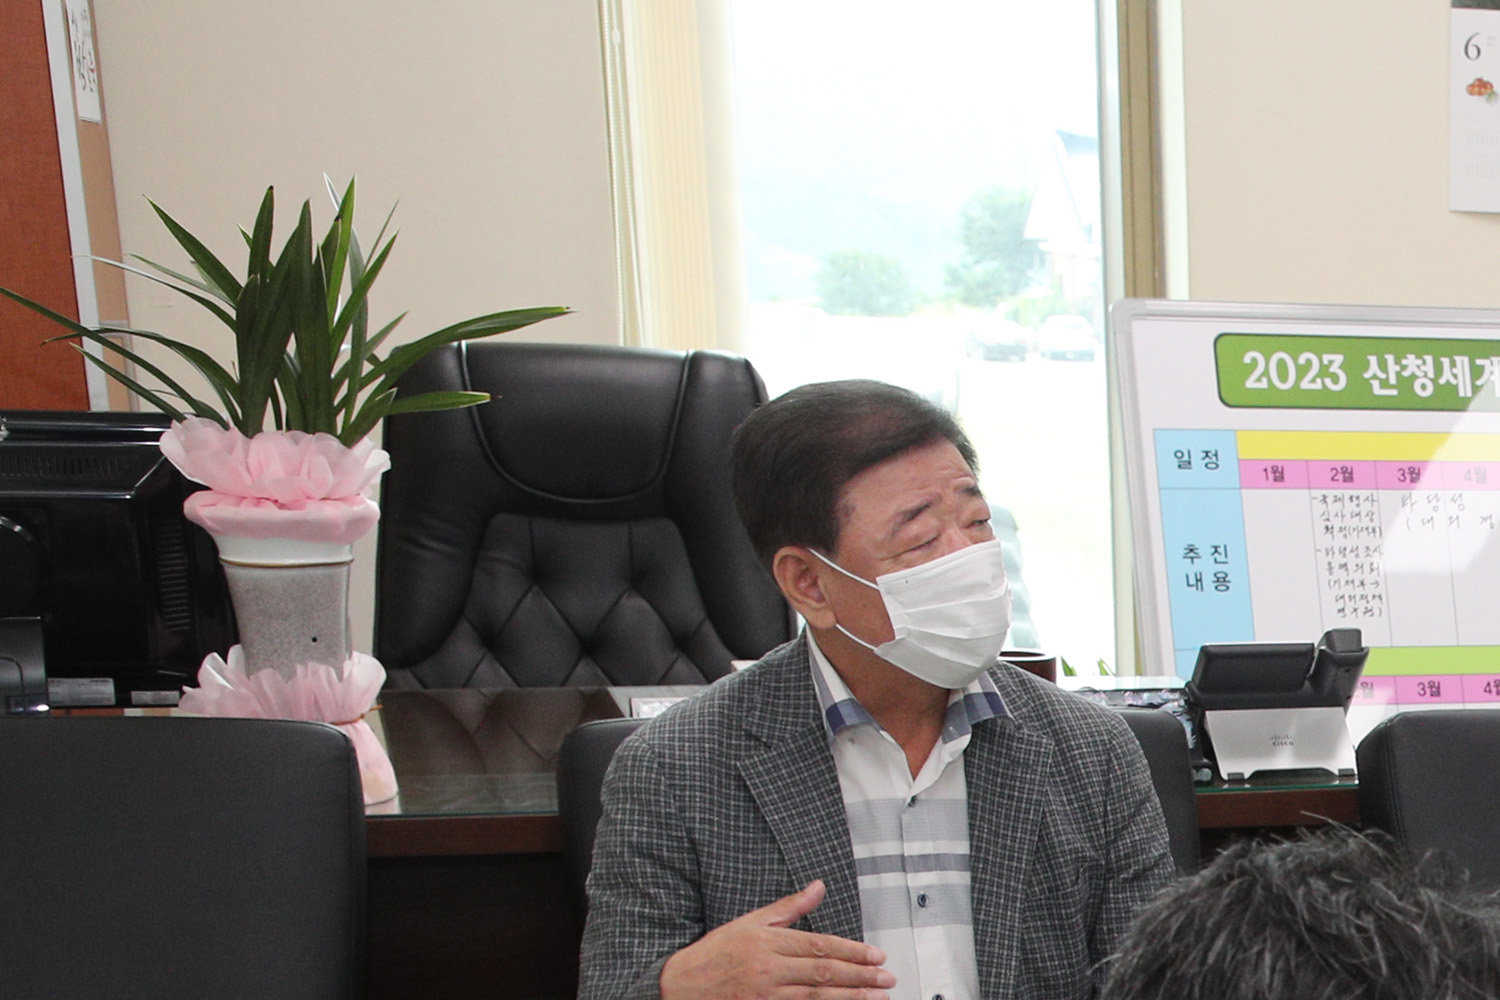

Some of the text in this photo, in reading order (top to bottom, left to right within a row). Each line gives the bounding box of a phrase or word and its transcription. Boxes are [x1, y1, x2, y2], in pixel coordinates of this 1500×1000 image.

[1463, 32, 1482, 61] 6
[1242, 350, 1348, 392] 2023
[1263, 465, 1286, 484] 1월
[1330, 466, 1355, 484] 2월
[1397, 467, 1421, 484] 3월
[1464, 467, 1488, 485] 4월
[1417, 680, 1441, 698] 3월
